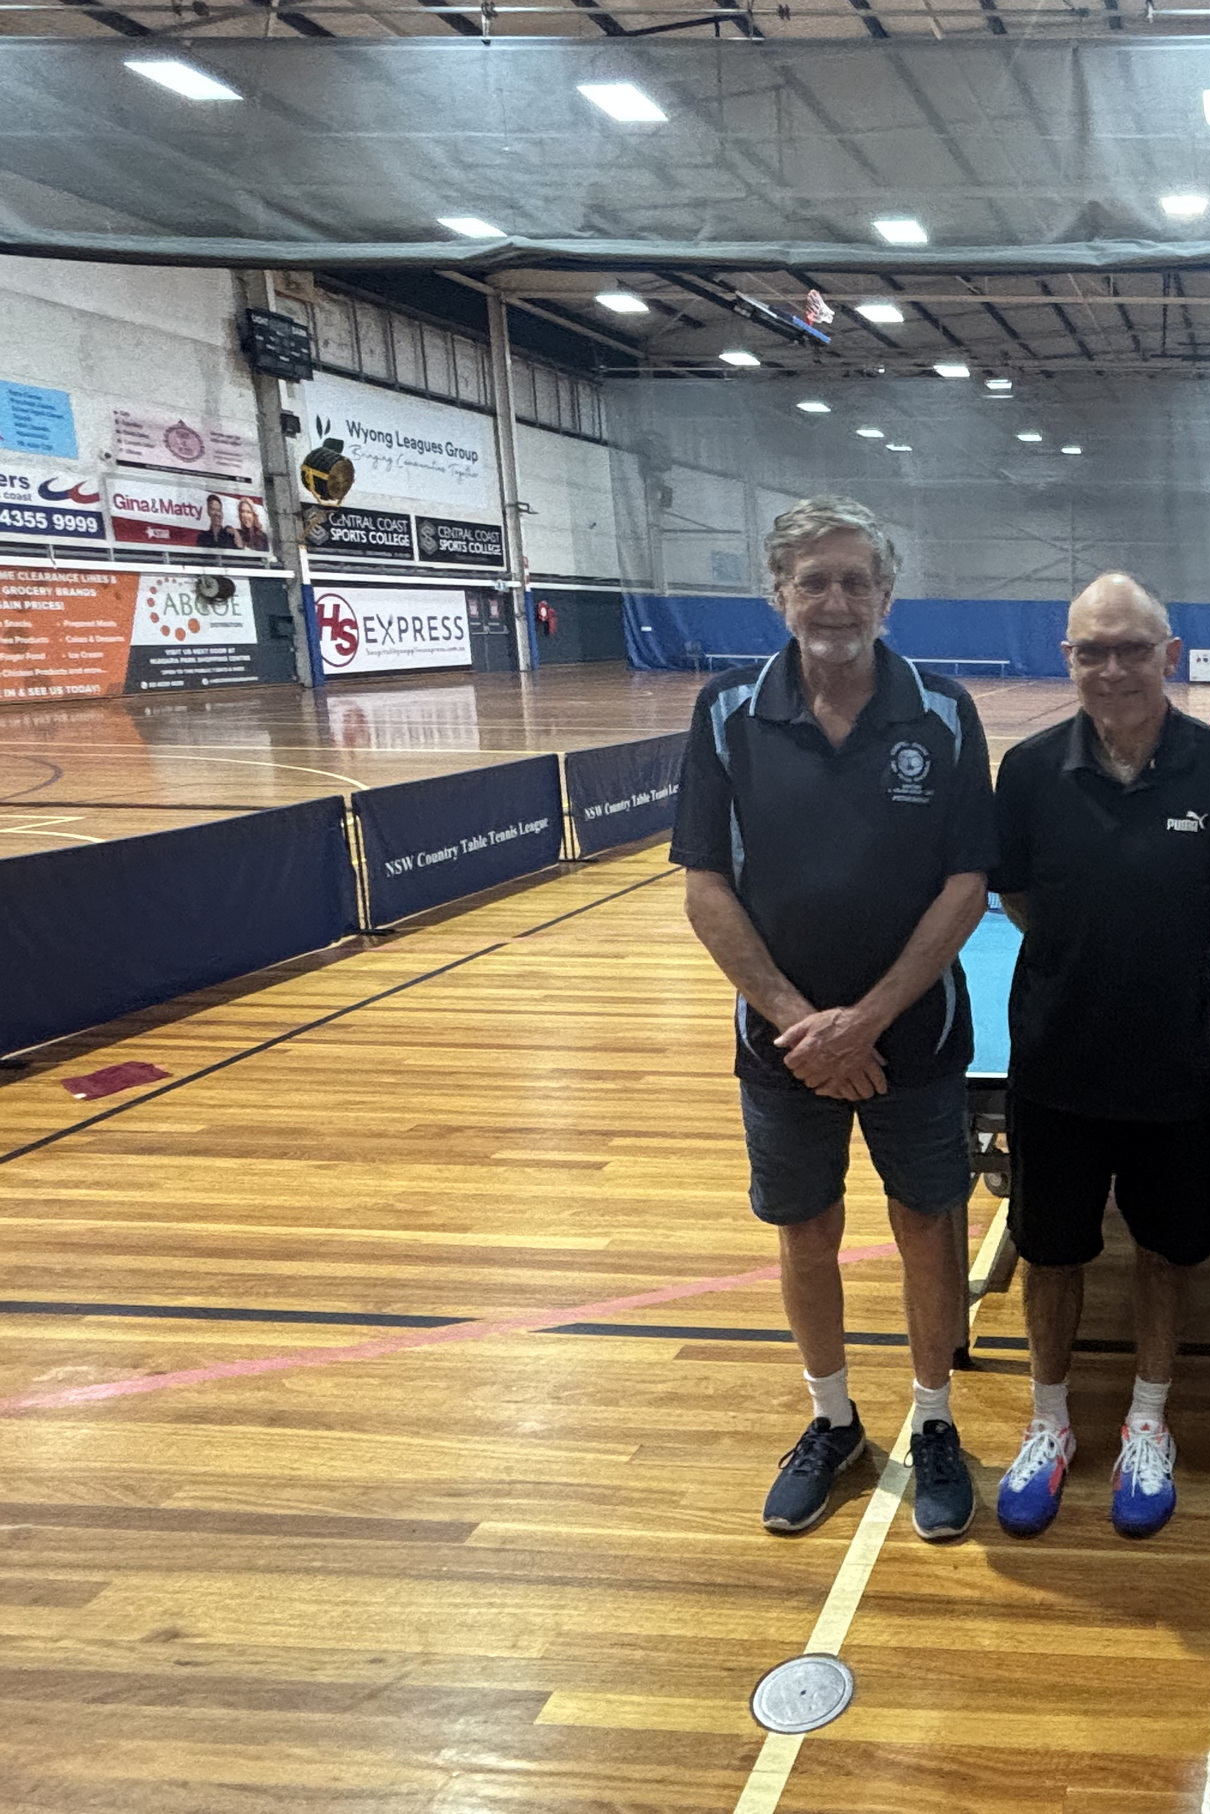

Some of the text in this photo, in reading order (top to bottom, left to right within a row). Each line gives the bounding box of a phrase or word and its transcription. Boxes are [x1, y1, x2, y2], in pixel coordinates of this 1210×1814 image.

[346, 420, 478, 464] Wyong Leagues Group
[3, 492, 32, 502] coast
[0, 509, 98, 533] 4355 9999
[376, 518, 408, 532] COAST
[330, 528, 410, 547] SPORTS COLLEGE
[437, 526, 500, 543] CENTRAL COAST
[439, 540, 502, 555] SPORTS COLLEGE
[18, 571, 78, 583] CLEARANCE
[2, 586, 97, 597] GROCERY BRANDS
[317, 603, 465, 656] HS EXPRESS
[27, 687, 47, 696] SEE
[584, 805, 603, 821] NSW
[604, 800, 631, 815] Country
[631, 792, 650, 807] Table
[1166, 818, 1198, 833] PUMA
[385, 818, 549, 878] NSW Country Table Tennis League
